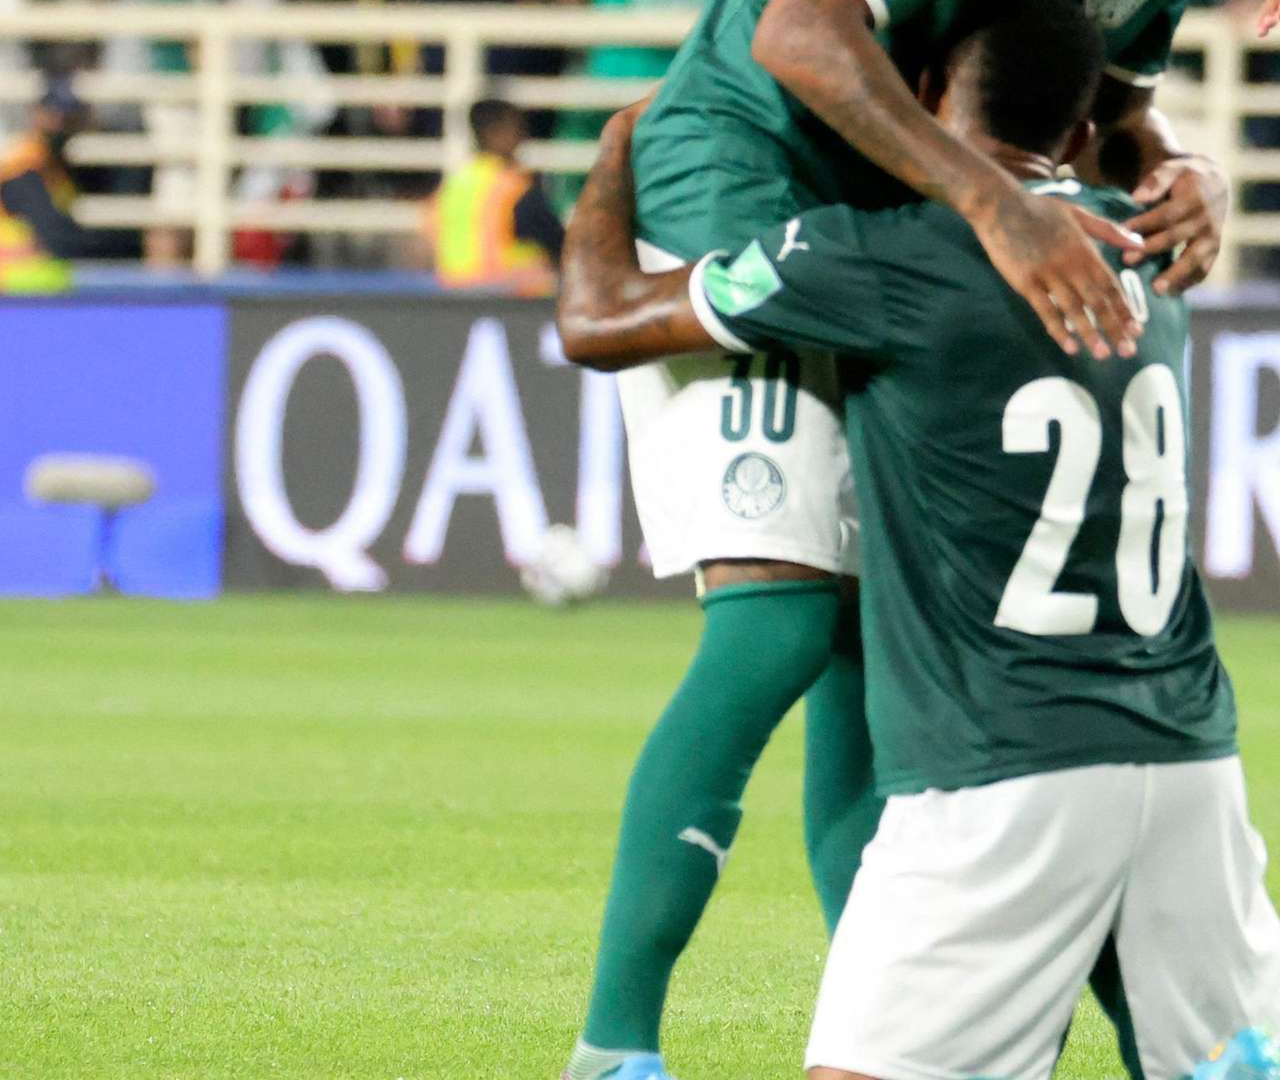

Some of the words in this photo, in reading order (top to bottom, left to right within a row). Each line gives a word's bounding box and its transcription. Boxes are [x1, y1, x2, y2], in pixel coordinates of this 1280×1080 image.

[235, 314, 626, 593] QAT
[720, 350, 799, 444] 30
[993, 363, 1190, 638] 28
